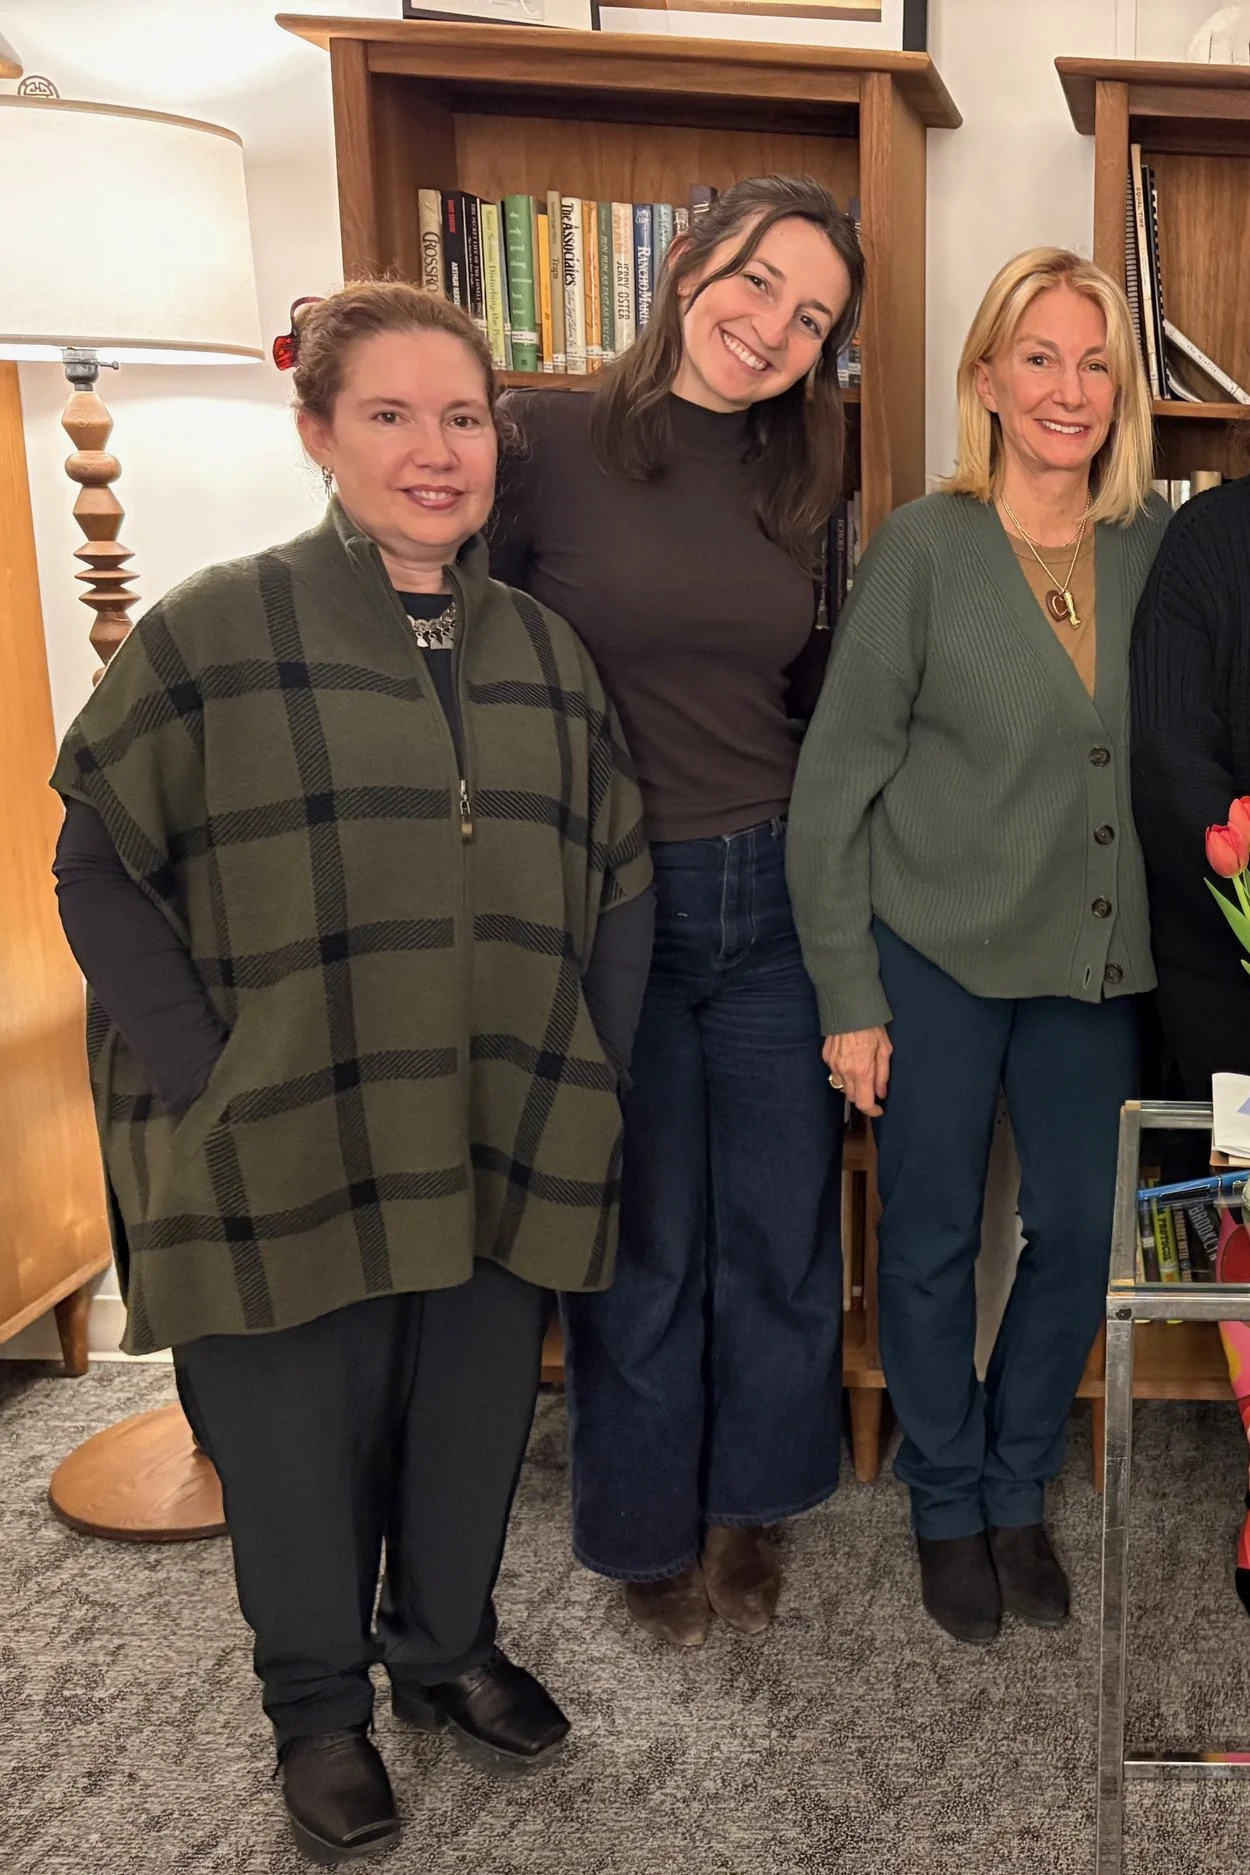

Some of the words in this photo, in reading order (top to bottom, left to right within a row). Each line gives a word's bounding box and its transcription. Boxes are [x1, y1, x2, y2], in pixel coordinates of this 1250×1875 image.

[562, 203, 574, 221] The
[563, 222, 580, 286] Associates
[551, 258, 560, 279] Traps
[617, 261, 629, 288] JERRY
[491, 312, 499, 326] the
[618, 292, 630, 320] OSTER
[1158, 1217, 1171, 1262] PROTOCOL
